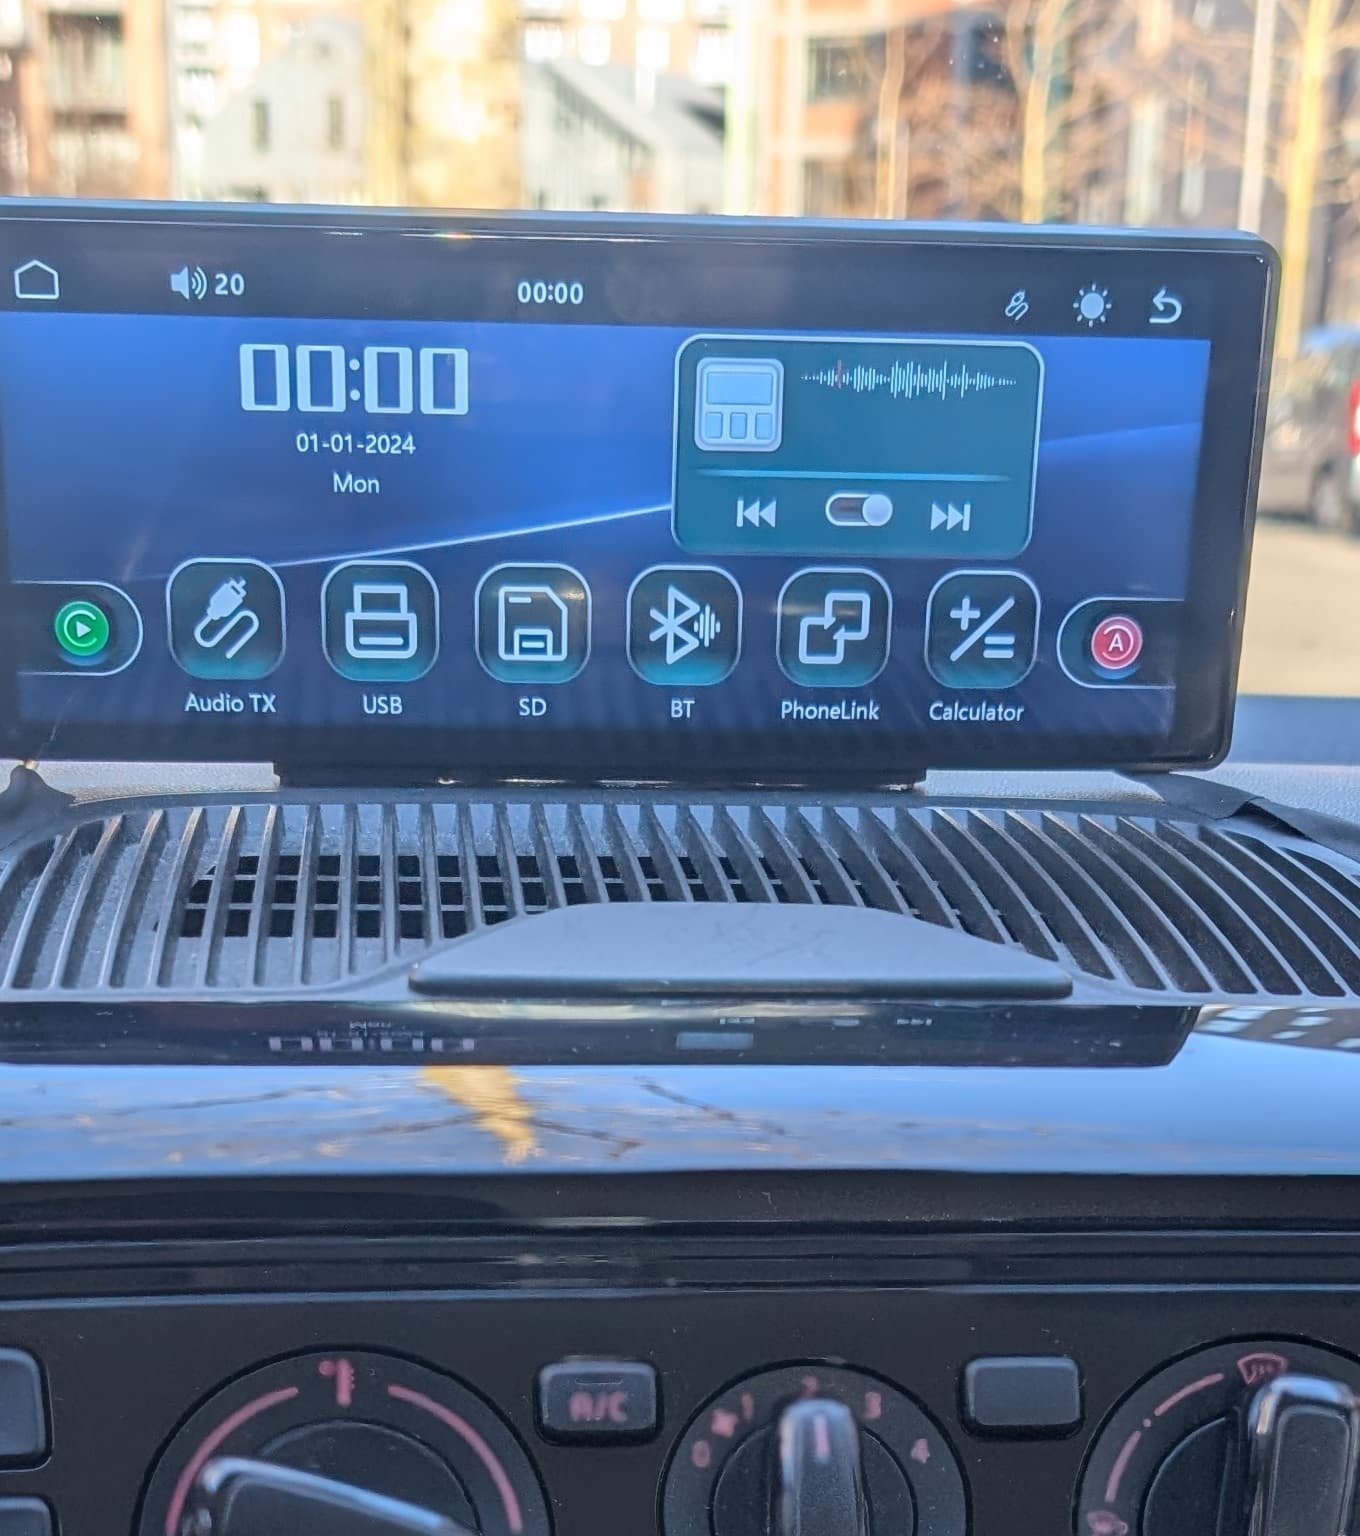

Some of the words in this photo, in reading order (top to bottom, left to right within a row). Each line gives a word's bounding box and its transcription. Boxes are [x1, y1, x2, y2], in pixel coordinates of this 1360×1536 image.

[213, 273, 246, 297] 20
[516, 282, 585, 305] 00:00
[239, 343, 470, 416] 00:00
[295, 432, 417, 457] 01-01-2024
[332, 472, 381, 495] Mon
[183, 693, 245, 715] Audio
[249, 694, 278, 715] TX
[361, 694, 404, 716] USB
[517, 696, 548, 717] SD
[670, 700, 696, 721] BT
[780, 699, 880, 723] PhoneLink
[928, 702, 1025, 725] Calculator
[568, 1390, 628, 1423] A/C
